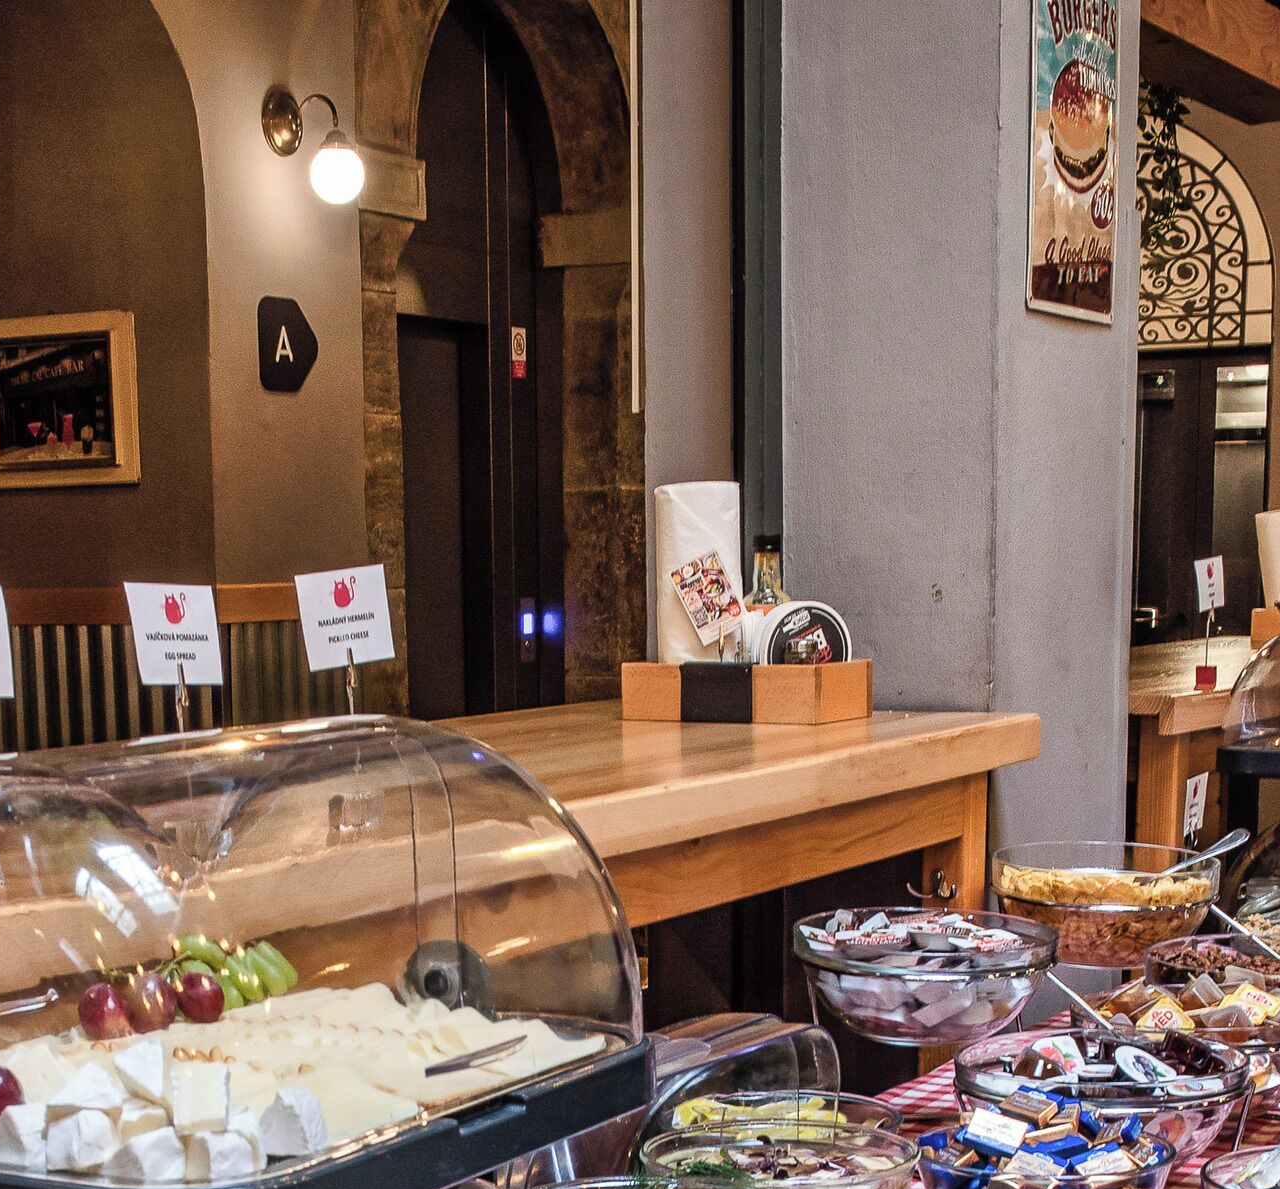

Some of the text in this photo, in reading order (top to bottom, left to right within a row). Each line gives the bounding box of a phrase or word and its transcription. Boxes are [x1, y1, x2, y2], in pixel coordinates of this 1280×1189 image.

[275, 325, 294, 363] A
[176, 631, 209, 642] POMAZÁNKA
[350, 631, 369, 641] CHEESE
[165, 652, 197, 660] EGG SPREAD
